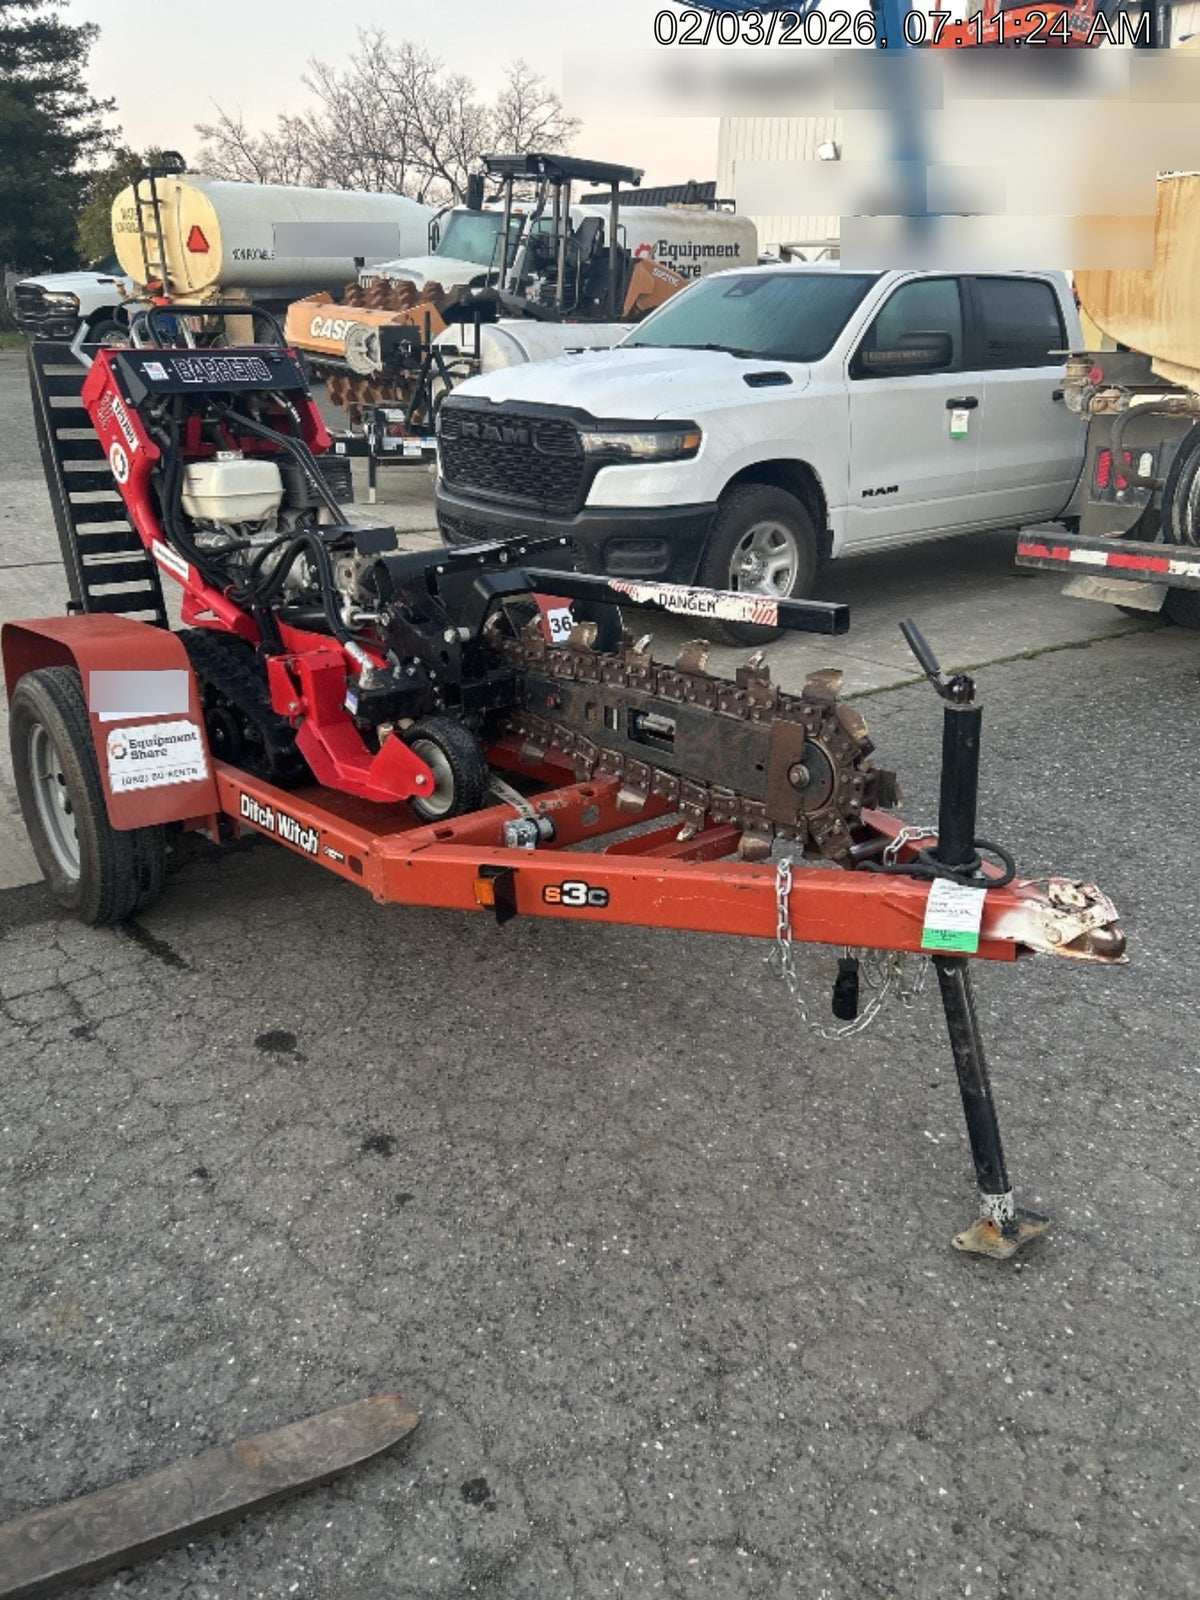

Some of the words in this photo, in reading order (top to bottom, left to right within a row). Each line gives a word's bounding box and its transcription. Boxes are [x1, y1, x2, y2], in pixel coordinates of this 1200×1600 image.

[658, 240, 740, 261] Equipment
[170, 356, 273, 383] BARRETO
[461, 421, 529, 445] RAM
[861, 485, 899, 498] RAM
[550, 616, 572, 634] 36
[128, 732, 198, 750] Equipment
[130, 748, 168, 761] Share
[241, 793, 275, 831] Ditch
[278, 812, 319, 855] Witch
